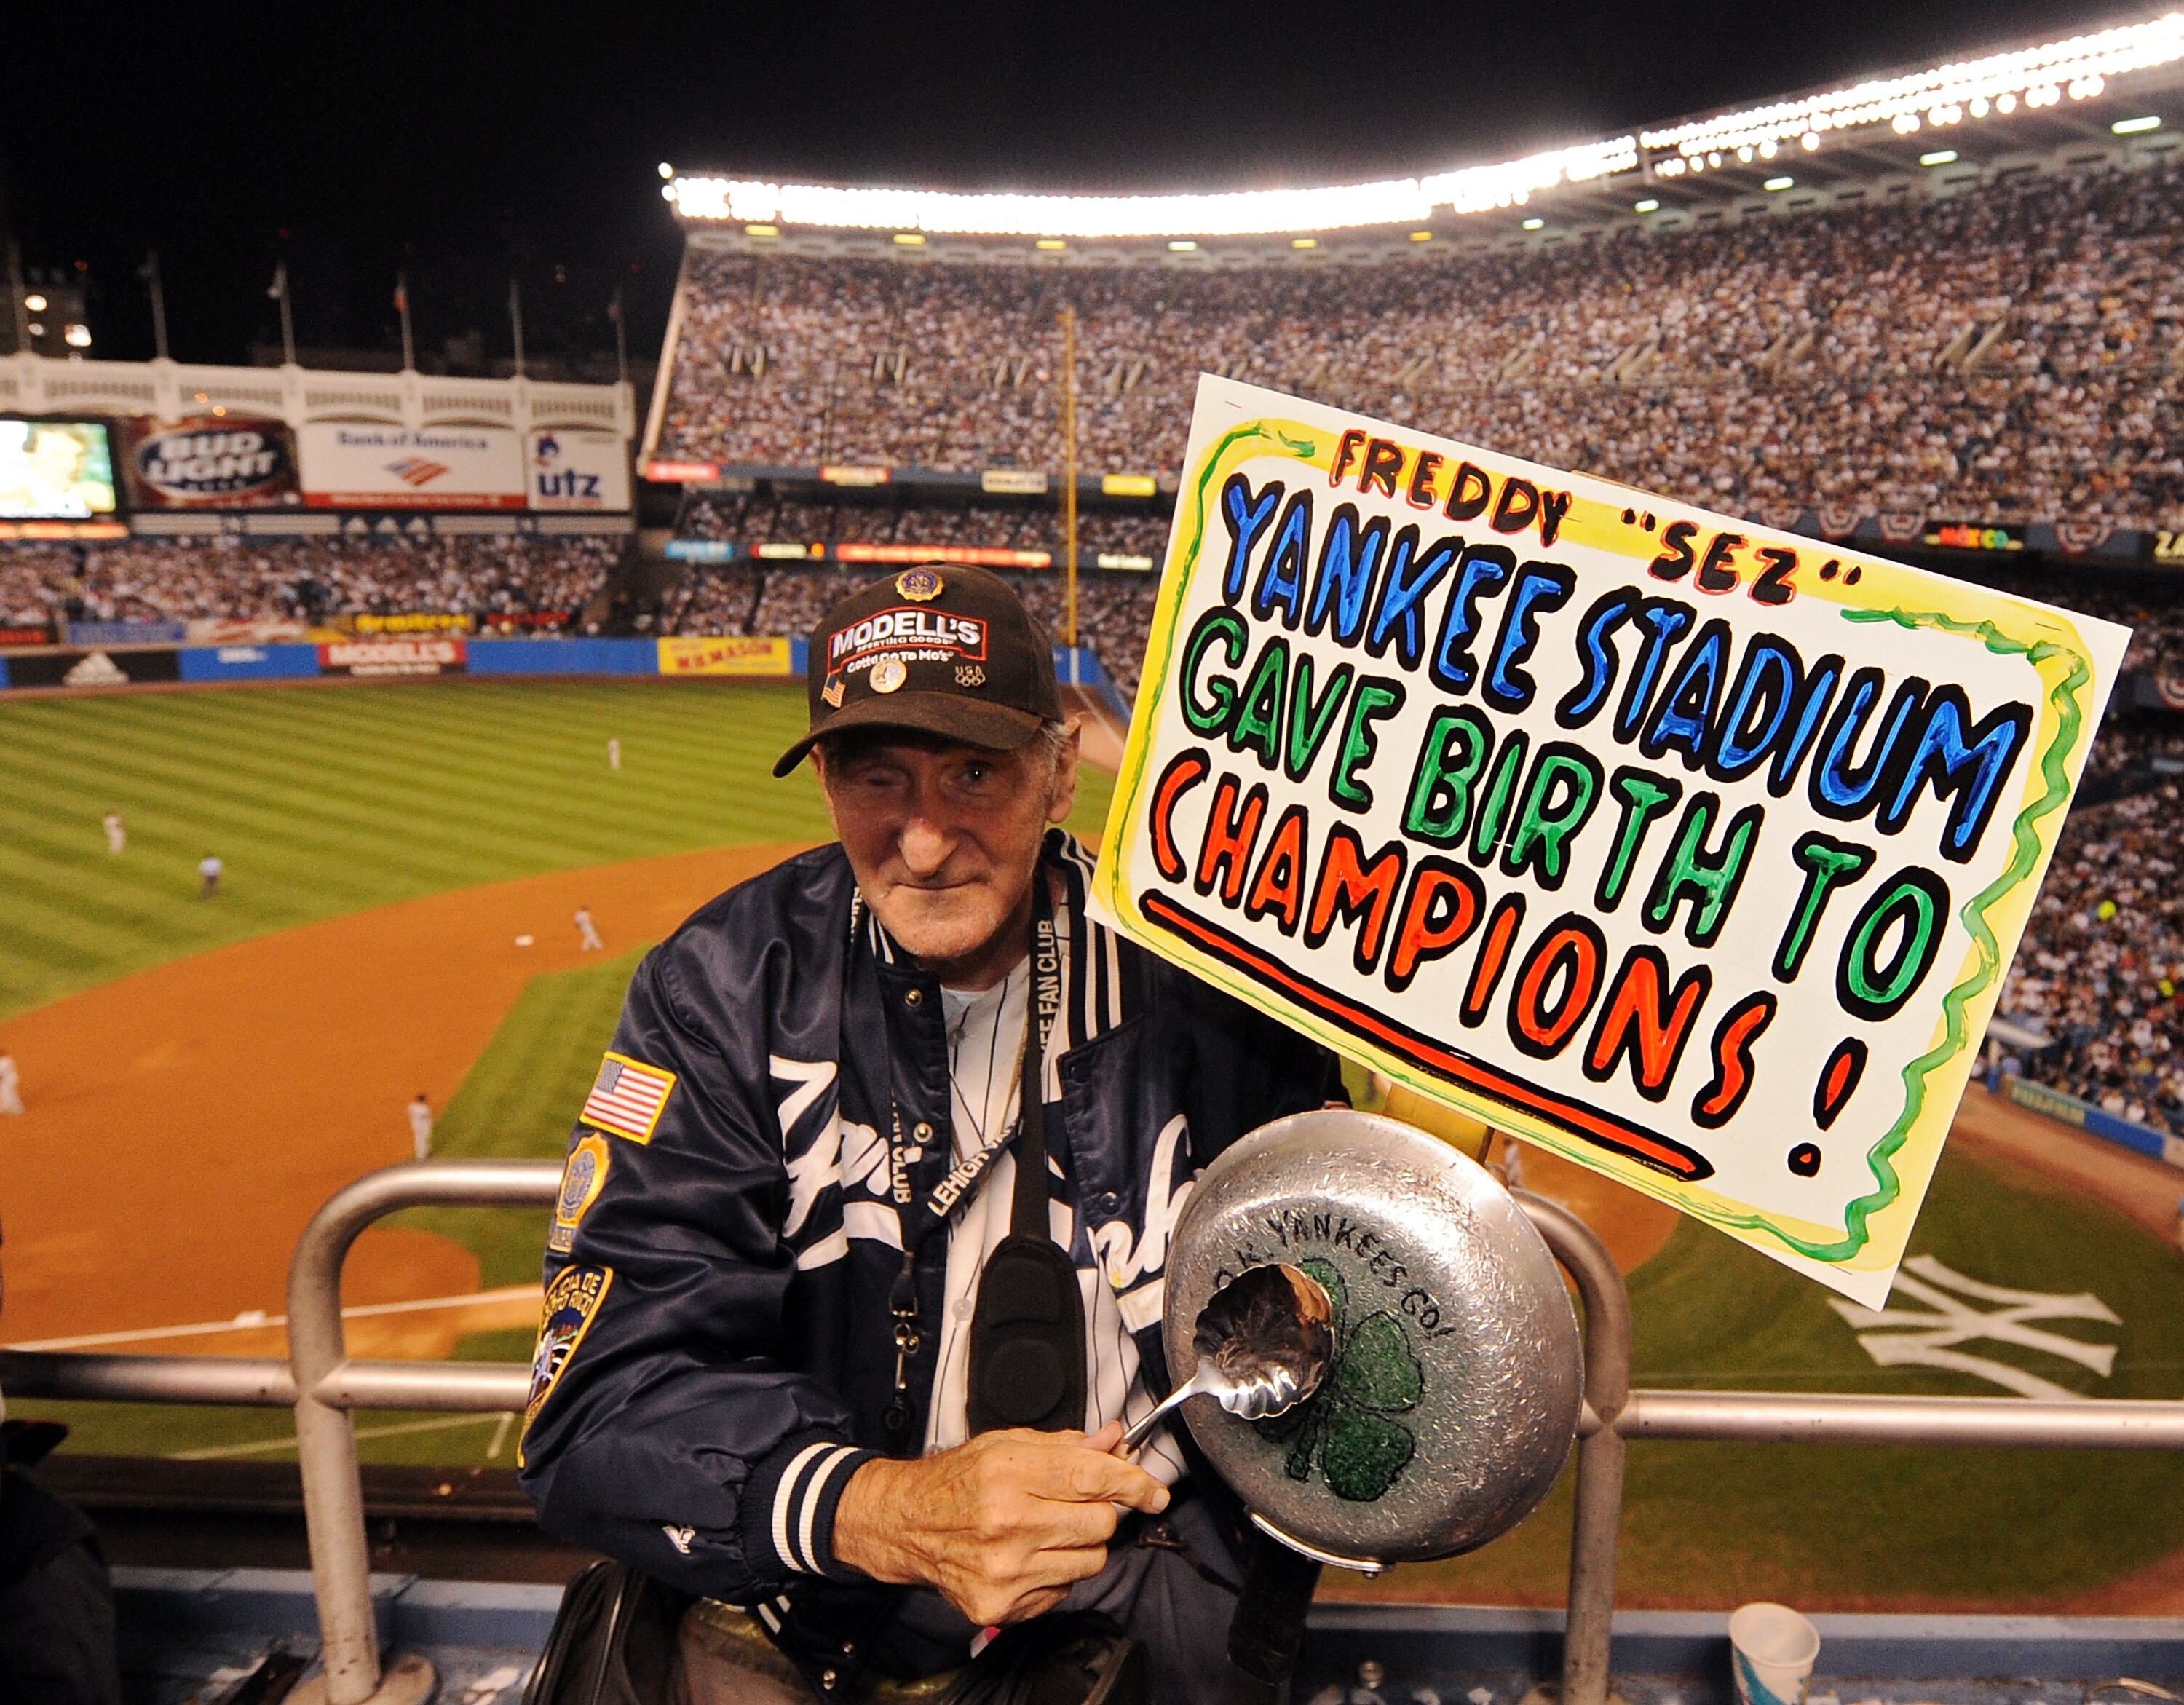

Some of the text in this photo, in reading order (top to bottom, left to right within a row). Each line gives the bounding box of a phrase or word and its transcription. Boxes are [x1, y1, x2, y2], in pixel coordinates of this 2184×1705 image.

[1329, 429, 1572, 547] FREDDY
[833, 612, 981, 658] MODELL'S
[1221, 472, 2033, 861] YANKEE STADIUM
[955, 665, 983, 674] USA
[1179, 616, 1952, 1021] GAVE BIRTH TO
[1037, 920, 1057, 973] CLUB
[1147, 746, 1777, 1130] CHAMPIONS
[1037, 976, 1060, 1015] FAN
[892, 1146, 911, 1204] CLUB
[927, 1152, 990, 1217] LEHIGH
[1268, 1211, 1408, 1289] YANKEES
